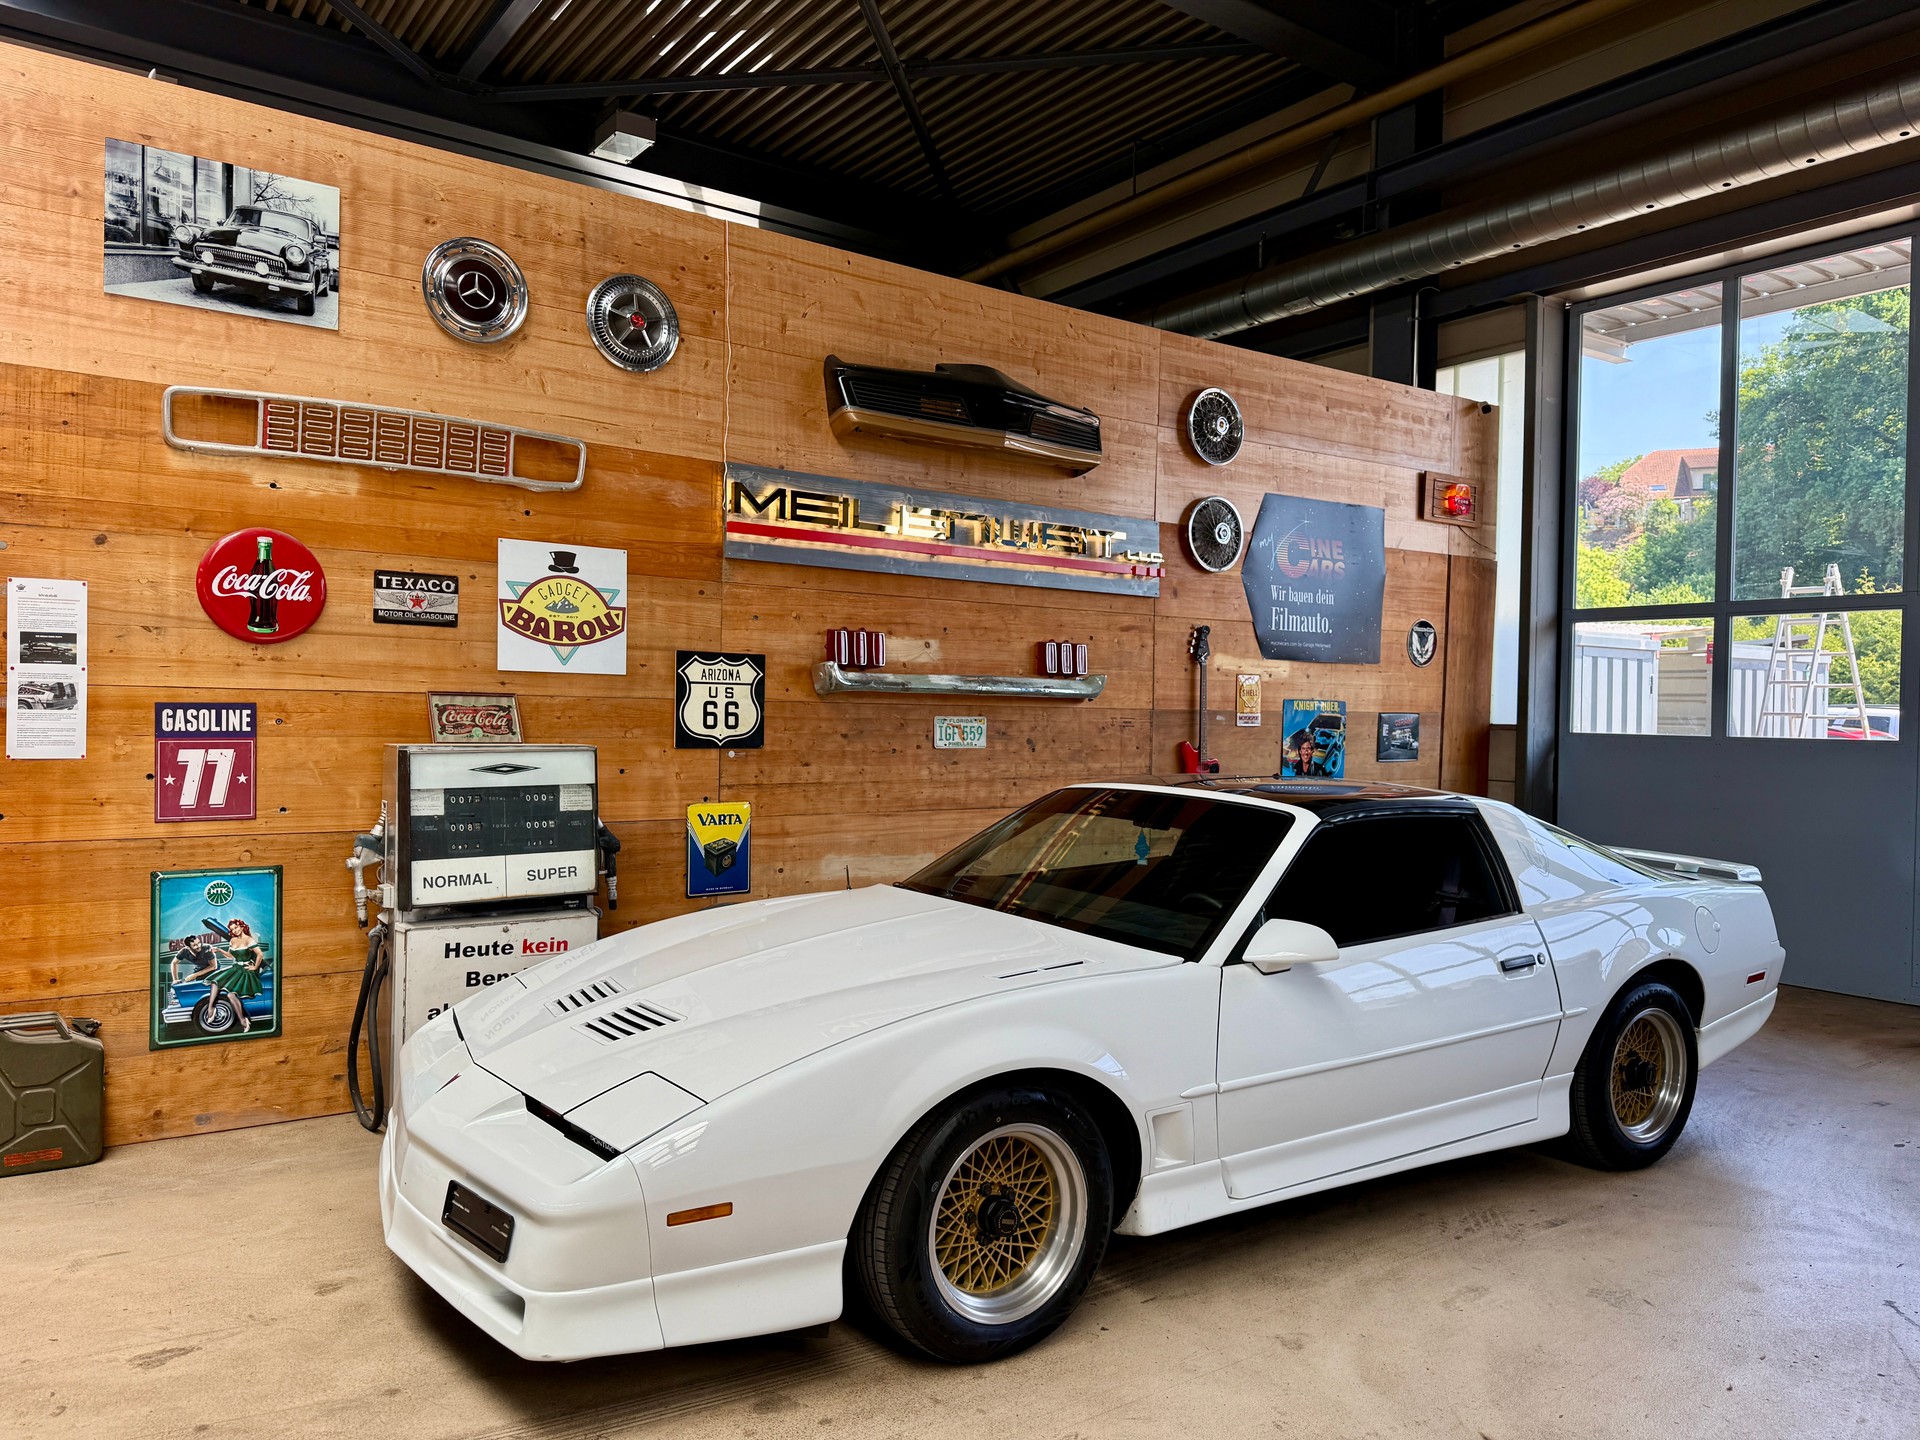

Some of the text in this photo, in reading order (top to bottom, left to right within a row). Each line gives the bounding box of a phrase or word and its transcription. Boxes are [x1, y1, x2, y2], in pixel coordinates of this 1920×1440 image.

[211, 565, 315, 602] Coca-Cola
[377, 575, 456, 593] TEXACO
[537, 582, 591, 603] GADGET
[1270, 584, 1335, 605] Wir bauen dein
[378, 609, 404, 618] MOTOR
[420, 613, 456, 621] GASOLINE
[507, 605, 621, 642] BARON
[1270, 606, 1333, 634] Filmauto.
[701, 668, 741, 681] ARIZONA
[1242, 689, 1258, 697] SHELL
[702, 700, 739, 730] 66
[1293, 700, 1318, 711] KNIGHT
[161, 708, 252, 732] GASOLINE
[441, 709, 509, 726] Coca-Cola
[176, 748, 236, 809] 77
[697, 812, 743, 827] VARTA
[422, 865, 578, 889] NORMAL SUPER
[444, 937, 569, 959] Heute kein
[466, 967, 528, 988] Ben
[589, 1134, 615, 1154] PONTIAC
